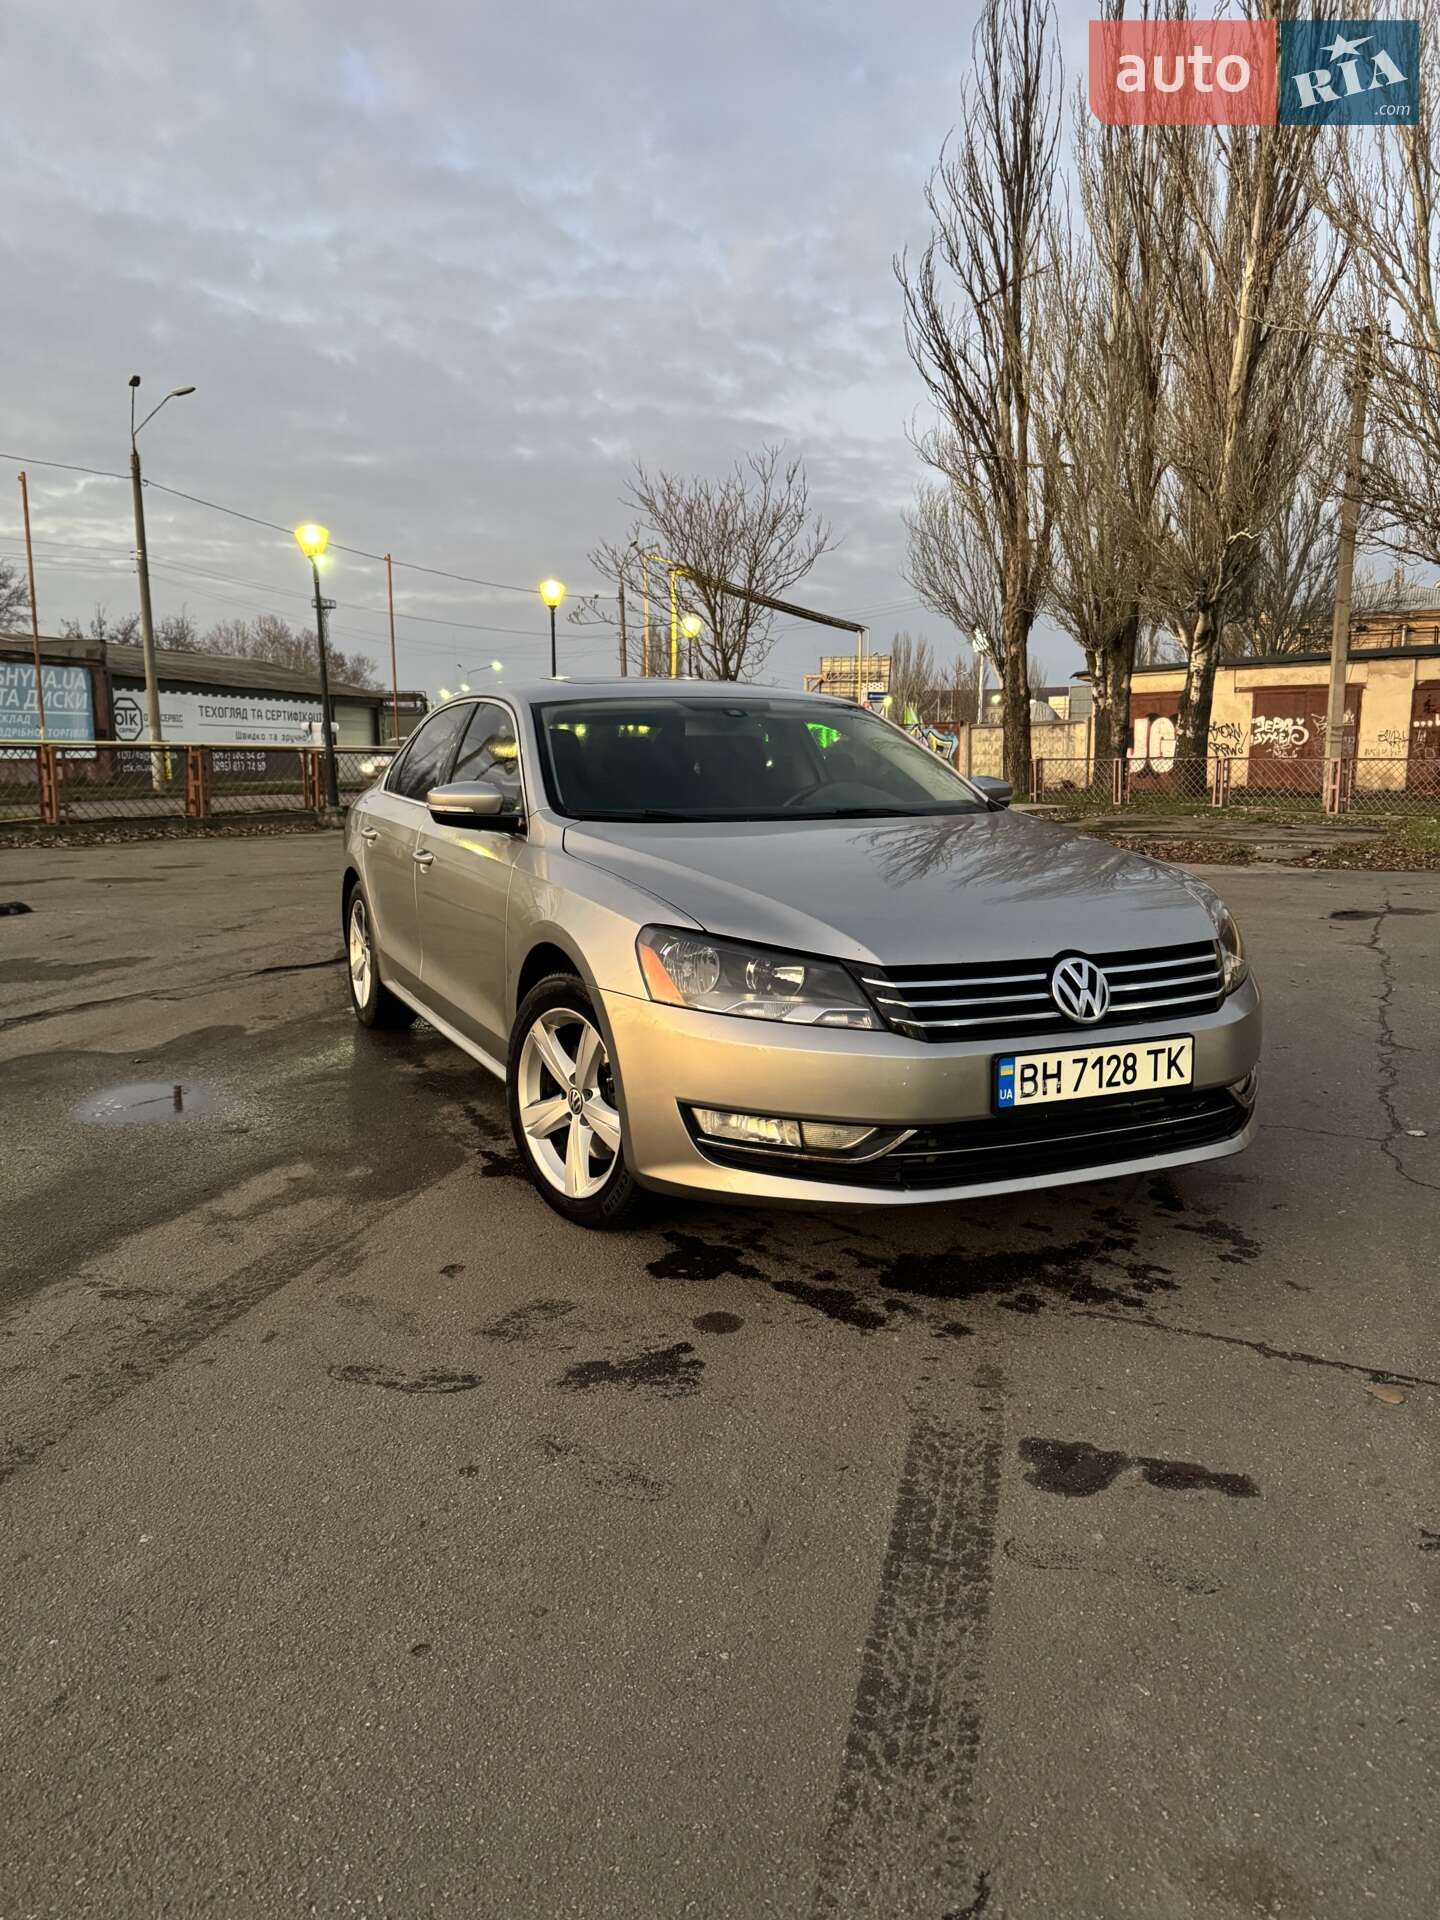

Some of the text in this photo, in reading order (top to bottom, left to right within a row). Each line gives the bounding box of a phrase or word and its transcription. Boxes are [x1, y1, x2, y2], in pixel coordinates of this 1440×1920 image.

[23, 689, 88, 710] ДИСКИ
[198, 705, 249, 720] ТЕХОГЛЯД
[251, 708, 263, 719] ТА
[1052, 957, 1110, 1024] VW
[1020, 1045, 1186, 1098] BH 7128 TK
[1000, 1090, 1013, 1100] UA
